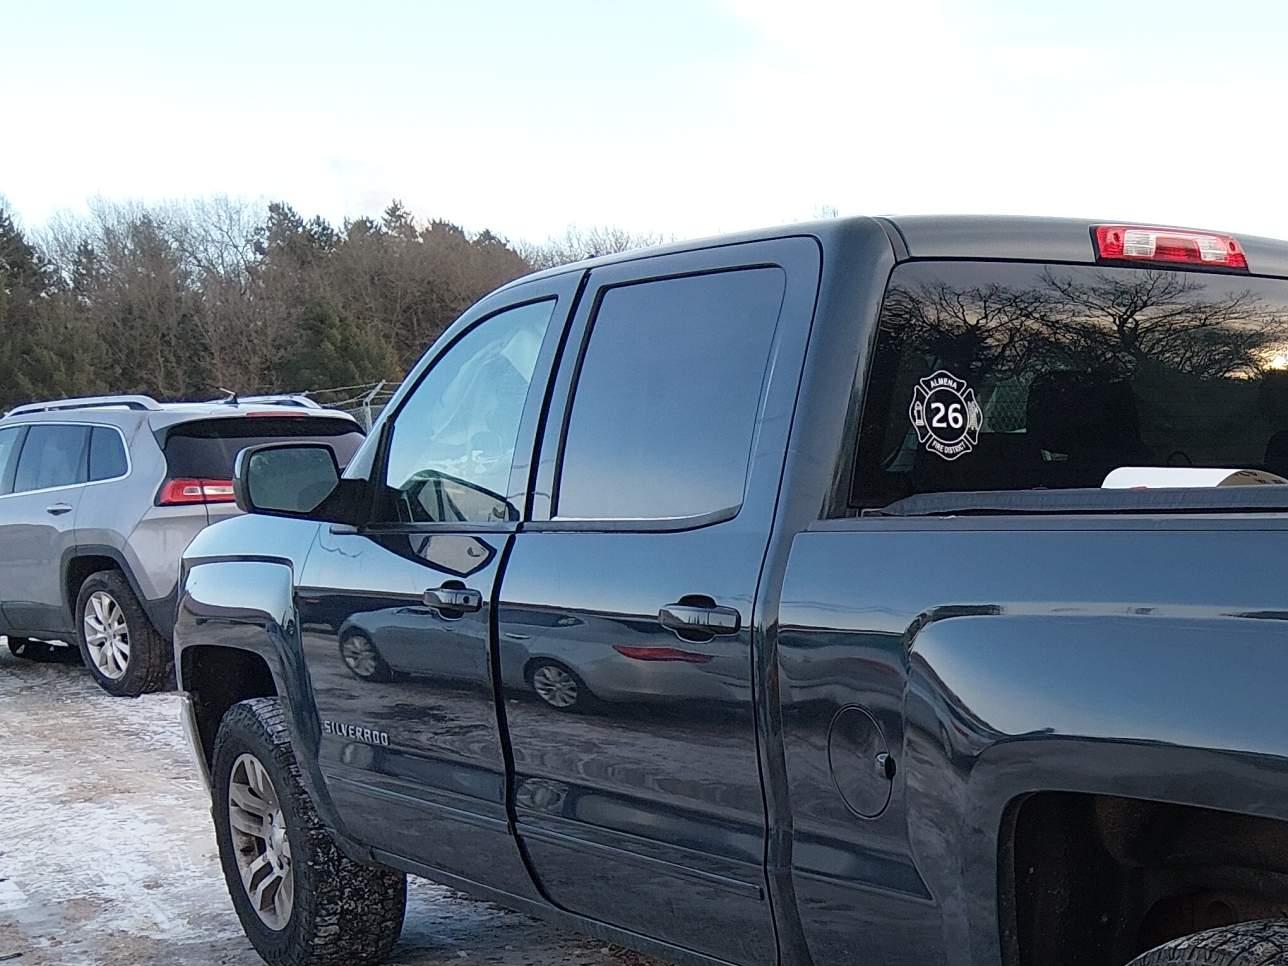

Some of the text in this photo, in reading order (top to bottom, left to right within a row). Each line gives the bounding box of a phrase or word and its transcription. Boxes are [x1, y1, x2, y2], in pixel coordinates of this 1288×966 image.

[930, 377, 957, 389] ALMENA
[930, 402, 963, 428] 26
[932, 440, 966, 453] FIRE DISTRICT
[323, 720, 389, 745] SILVERADO
